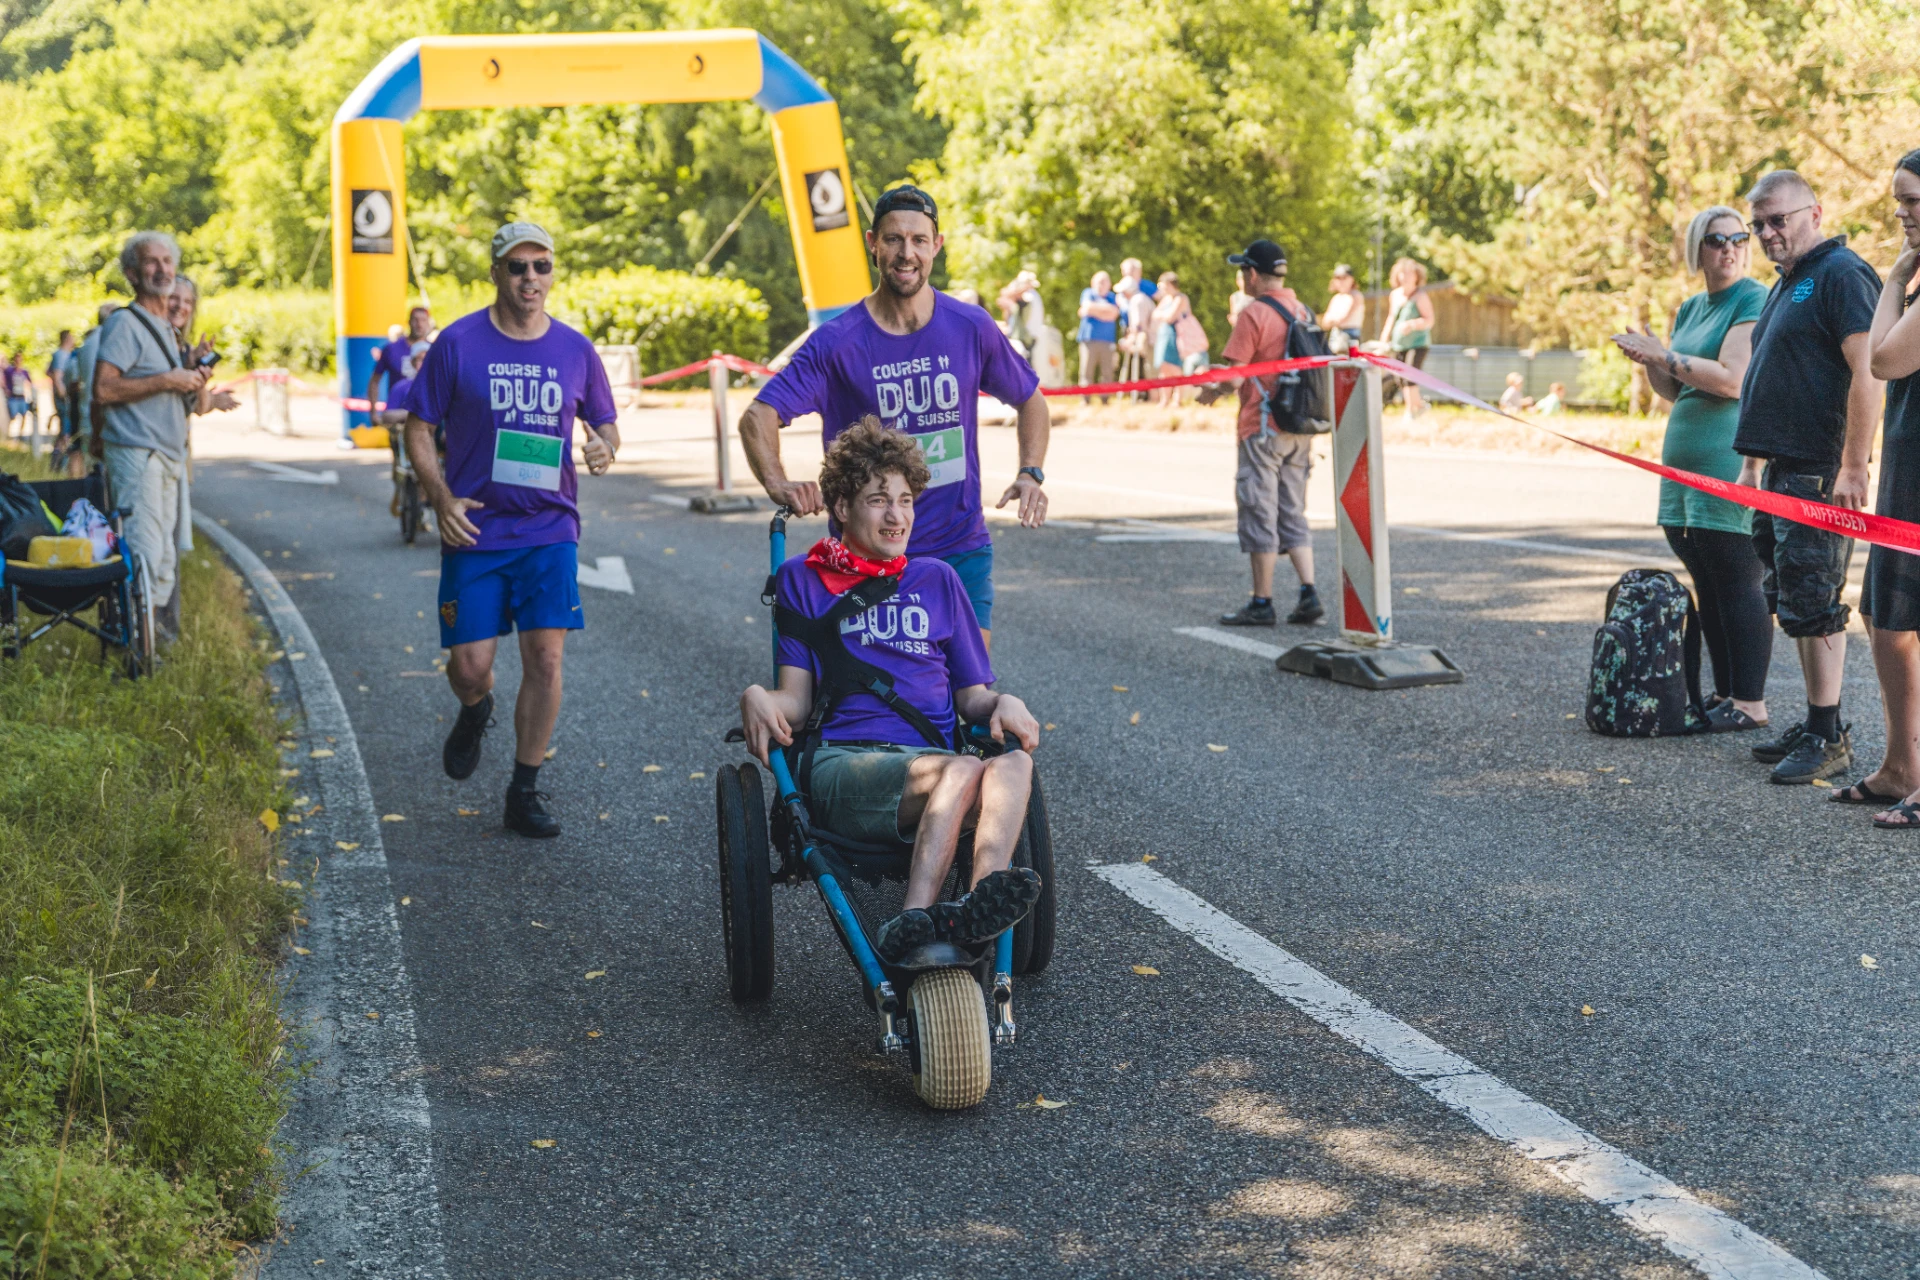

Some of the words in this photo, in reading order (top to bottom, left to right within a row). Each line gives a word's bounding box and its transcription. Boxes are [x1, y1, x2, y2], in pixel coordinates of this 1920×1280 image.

[488, 363, 541, 377] COURSE
[872, 357, 932, 380] COURSE
[490, 378, 563, 414] DUO
[876, 372, 959, 418] DUO
[523, 413, 559, 426] SUISSE
[917, 410, 960, 427] SUISSE
[522, 439, 547, 460] 52
[519, 467, 541, 480] DUO
[1800, 502, 1867, 533] RAIFFEISEN
[884, 640, 929, 655] ISSE
